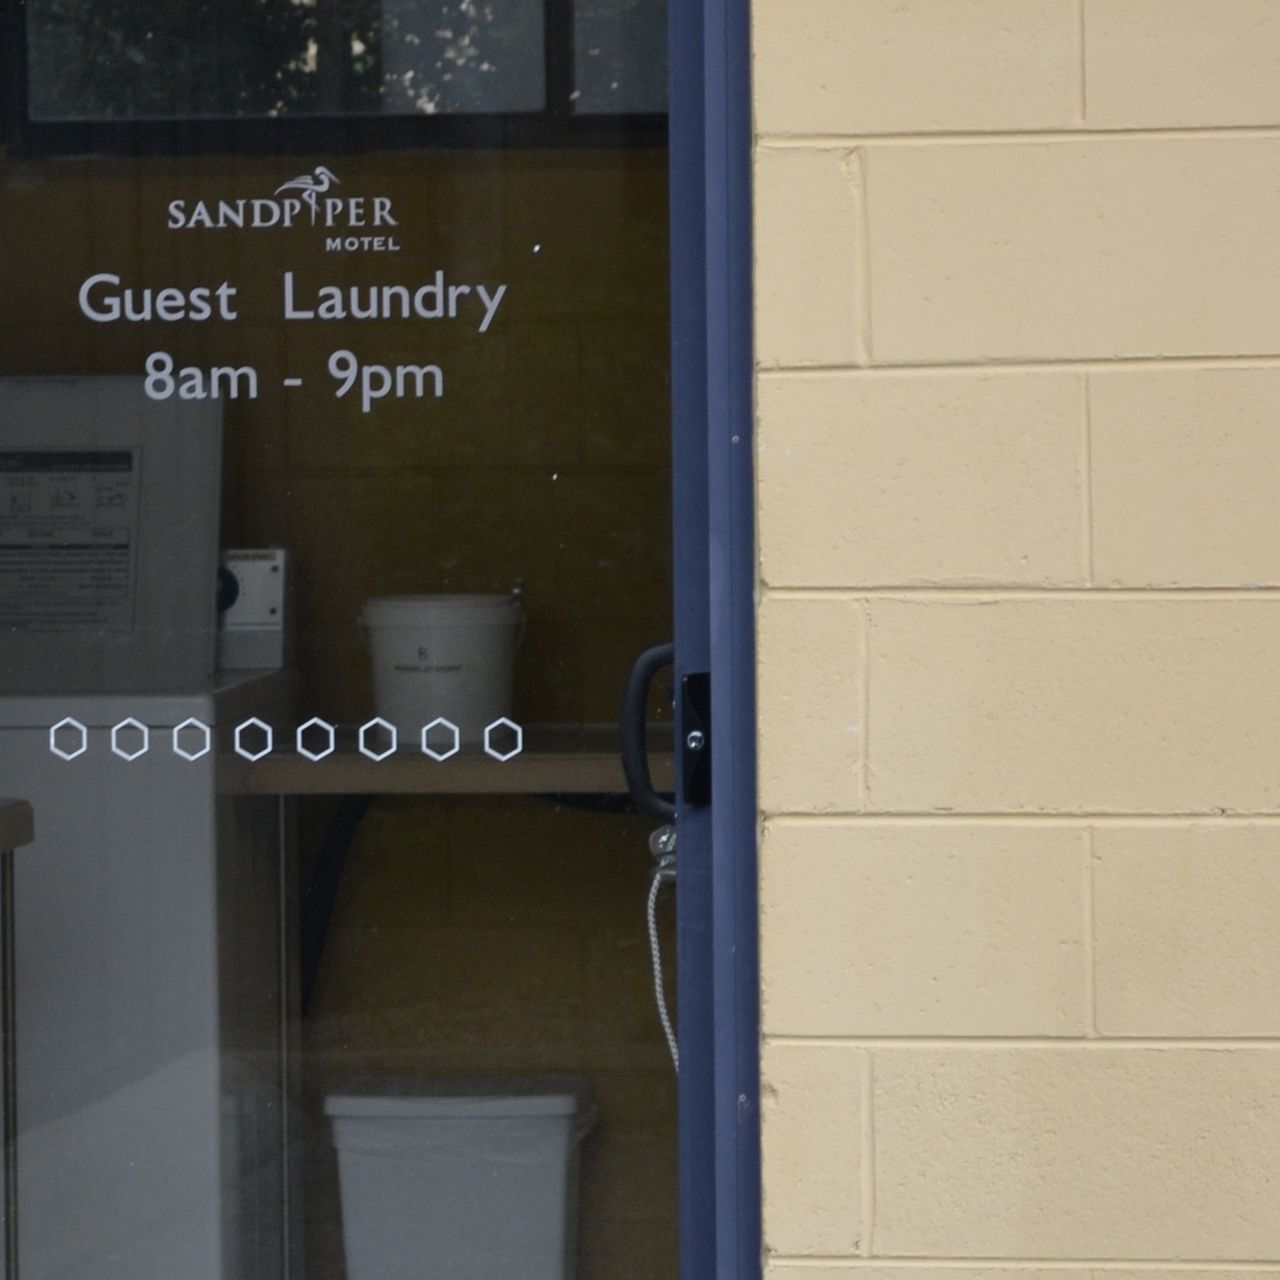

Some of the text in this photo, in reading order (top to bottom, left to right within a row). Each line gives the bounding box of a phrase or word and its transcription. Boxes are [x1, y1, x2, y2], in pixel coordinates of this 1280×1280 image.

[325, 236, 401, 252] MOTEL
[77, 269, 508, 334] Guest Laundry
[143, 347, 445, 414] 8am - 9pm
